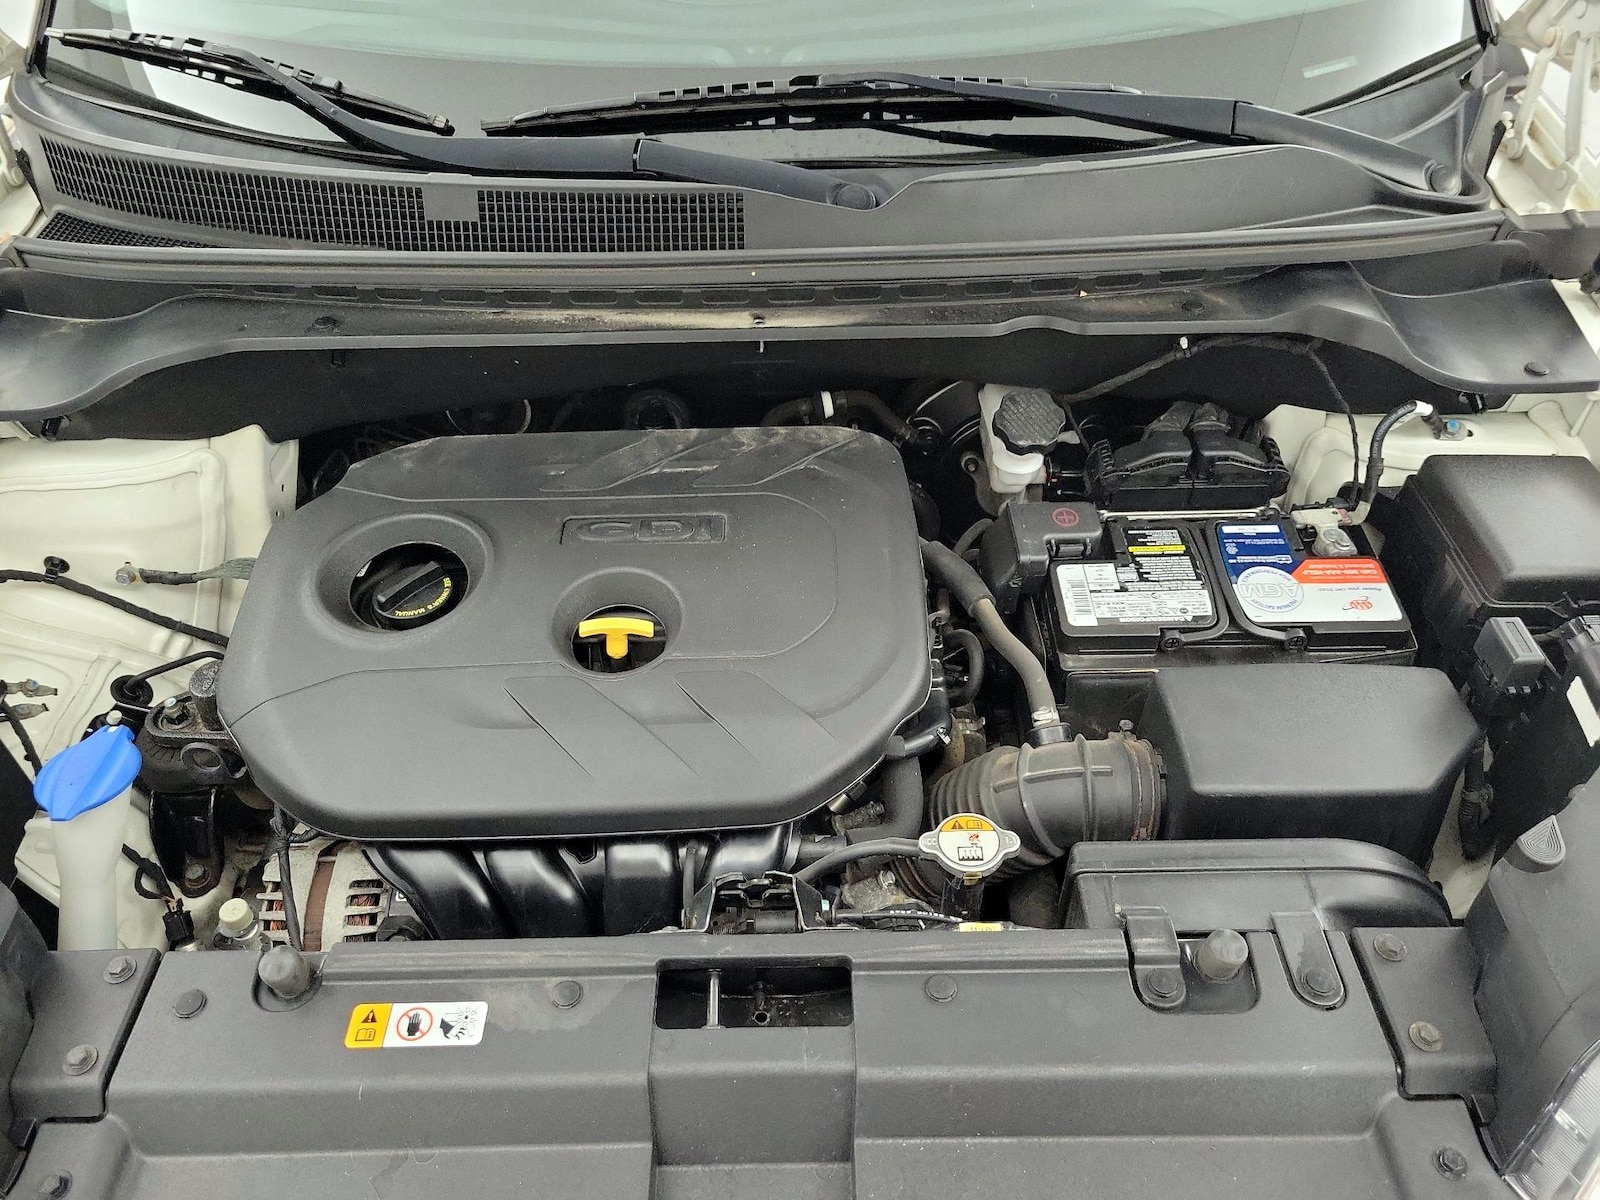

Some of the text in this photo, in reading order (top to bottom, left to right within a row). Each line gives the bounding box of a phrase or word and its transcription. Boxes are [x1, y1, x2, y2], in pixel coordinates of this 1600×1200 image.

[574, 518, 712, 542] GDI
[1239, 582, 1299, 599] AGM
[395, 607, 426, 617] MANUAL
